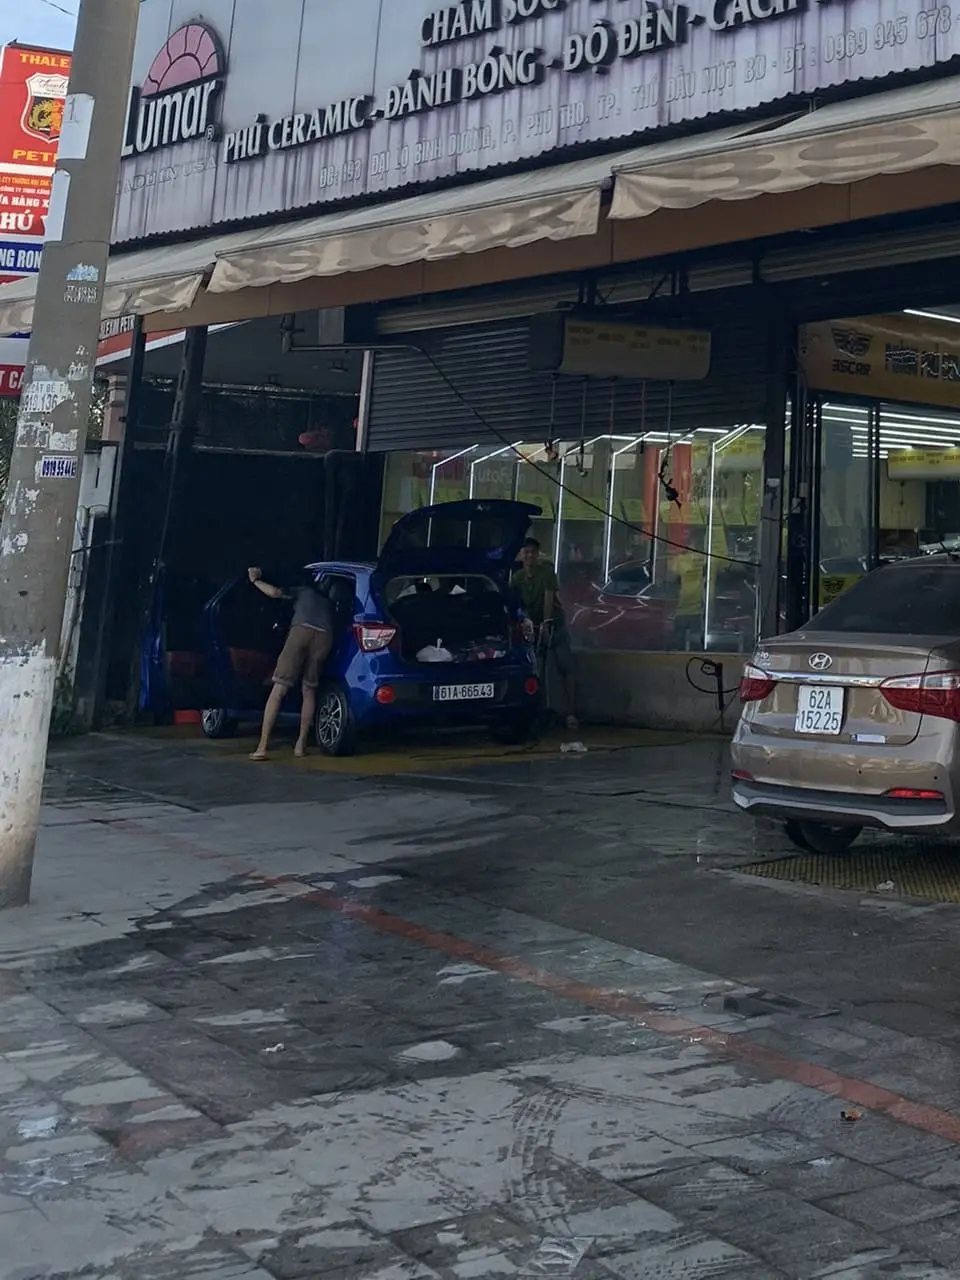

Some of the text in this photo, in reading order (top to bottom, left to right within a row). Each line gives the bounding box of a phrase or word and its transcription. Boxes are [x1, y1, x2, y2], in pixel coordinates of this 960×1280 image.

[824, 26, 868, 63] 0969
[873, 16, 908, 51] 945
[916, 4, 952, 40] 678
[20, 53, 71, 68] THALE
[267, 94, 366, 151] CERAMIC
[383, 69, 452, 119] ĐÁNH
[461, 45, 536, 99] BÓNG
[563, 19, 608, 73] ĐỘ
[617, 0, 679, 57] ĐÈN
[0, 209, 35, 232] HÚ
[808, 689, 832, 709] 62A
[798, 710, 840, 731] 152.25
